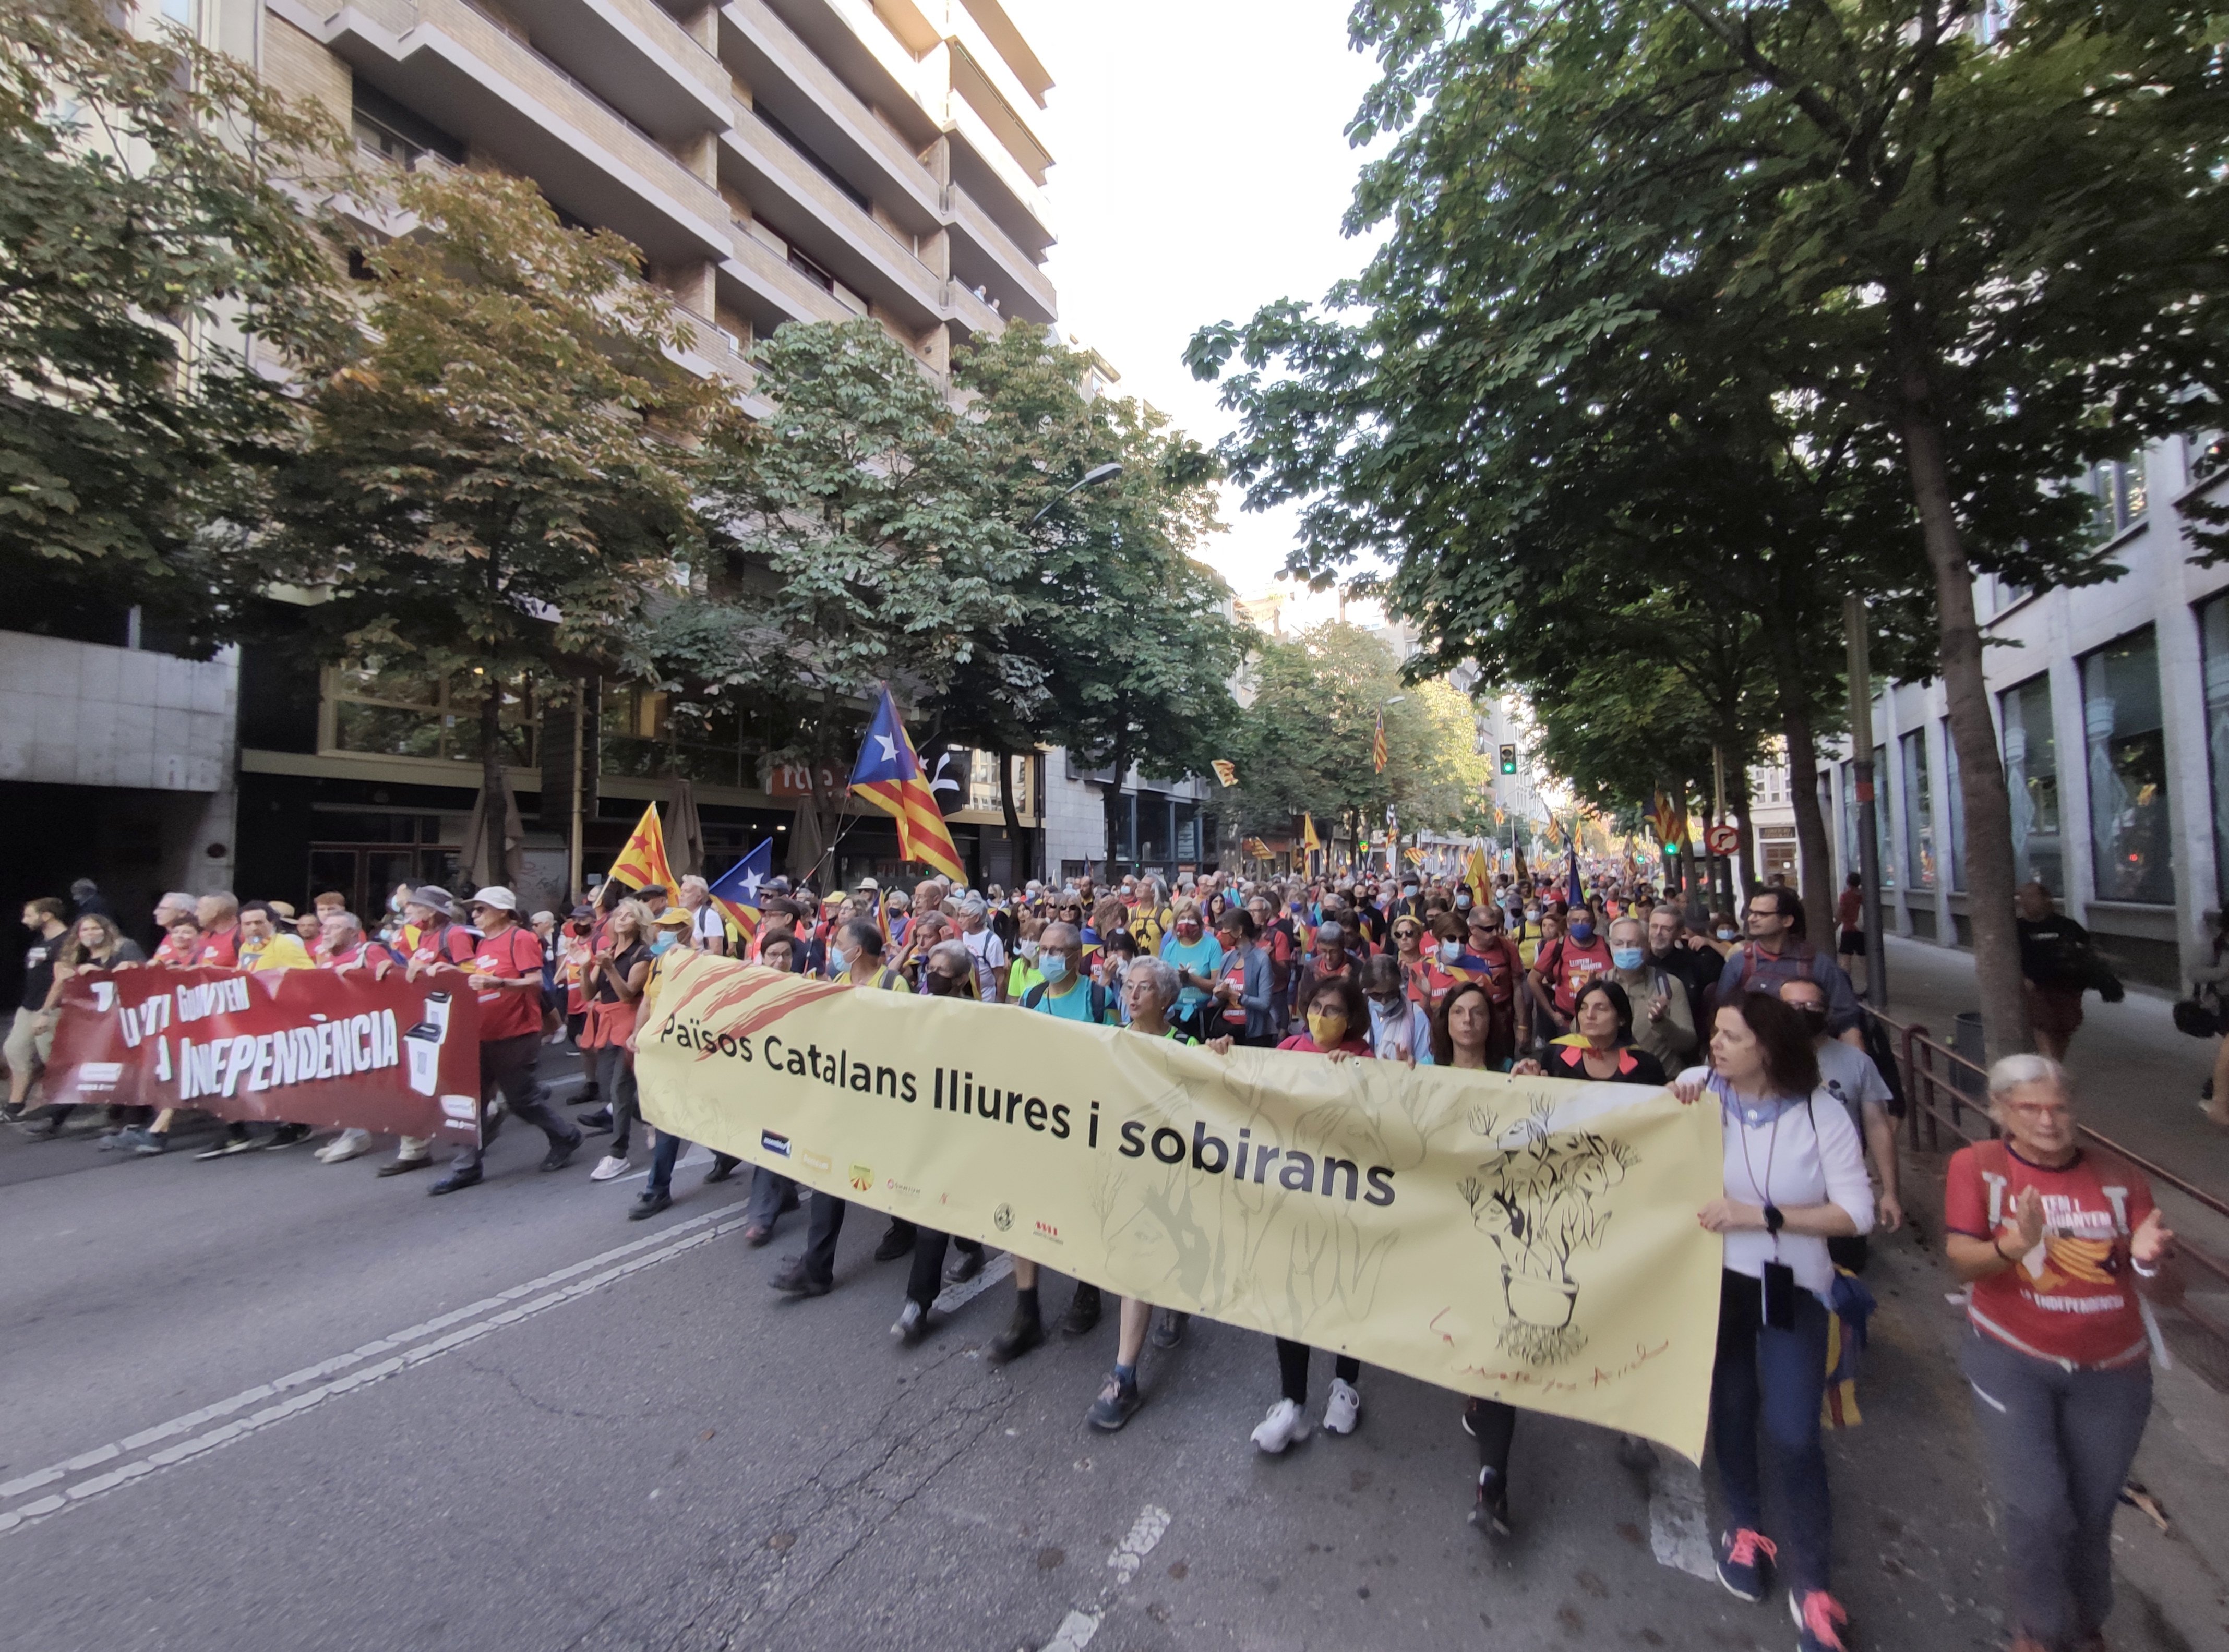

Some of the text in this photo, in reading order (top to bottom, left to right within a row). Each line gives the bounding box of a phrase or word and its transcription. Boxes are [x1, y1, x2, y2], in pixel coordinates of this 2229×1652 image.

[660, 1012, 1396, 1207] Països Catalans lliures i sobirans
